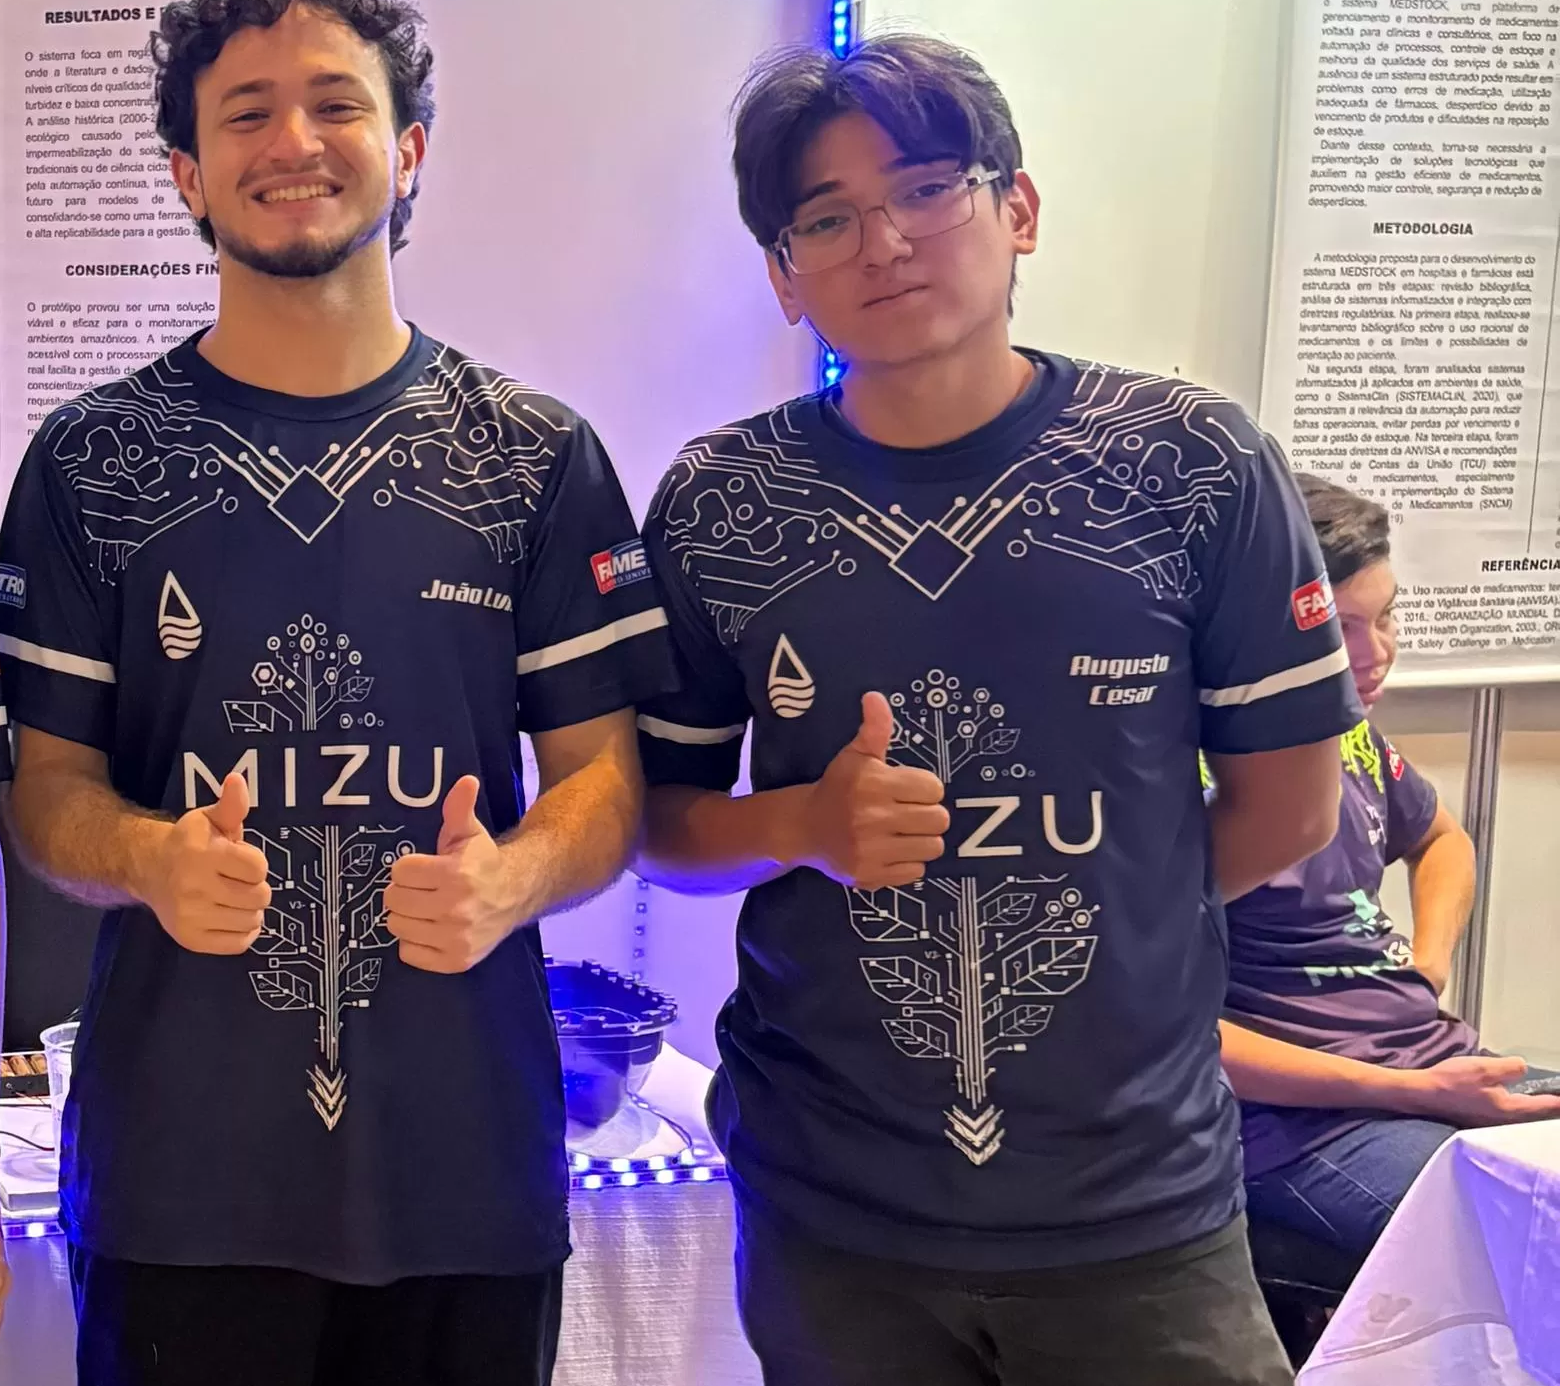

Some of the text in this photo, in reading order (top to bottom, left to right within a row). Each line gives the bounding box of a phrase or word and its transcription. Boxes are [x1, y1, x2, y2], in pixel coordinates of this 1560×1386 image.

[46, 8, 155, 23] RESULTADOS E
[99, 196, 138, 205] modelos
[1373, 222, 1473, 235] METODOLOGIA
[65, 263, 191, 279] CONSIDERAÇÕES
[1482, 558, 1560, 571] REFERÊNCIA
[421, 579, 482, 605] João
[1069, 654, 1170, 679] Augusto
[1089, 684, 1158, 706] César
[183, 744, 443, 809] MIZU
